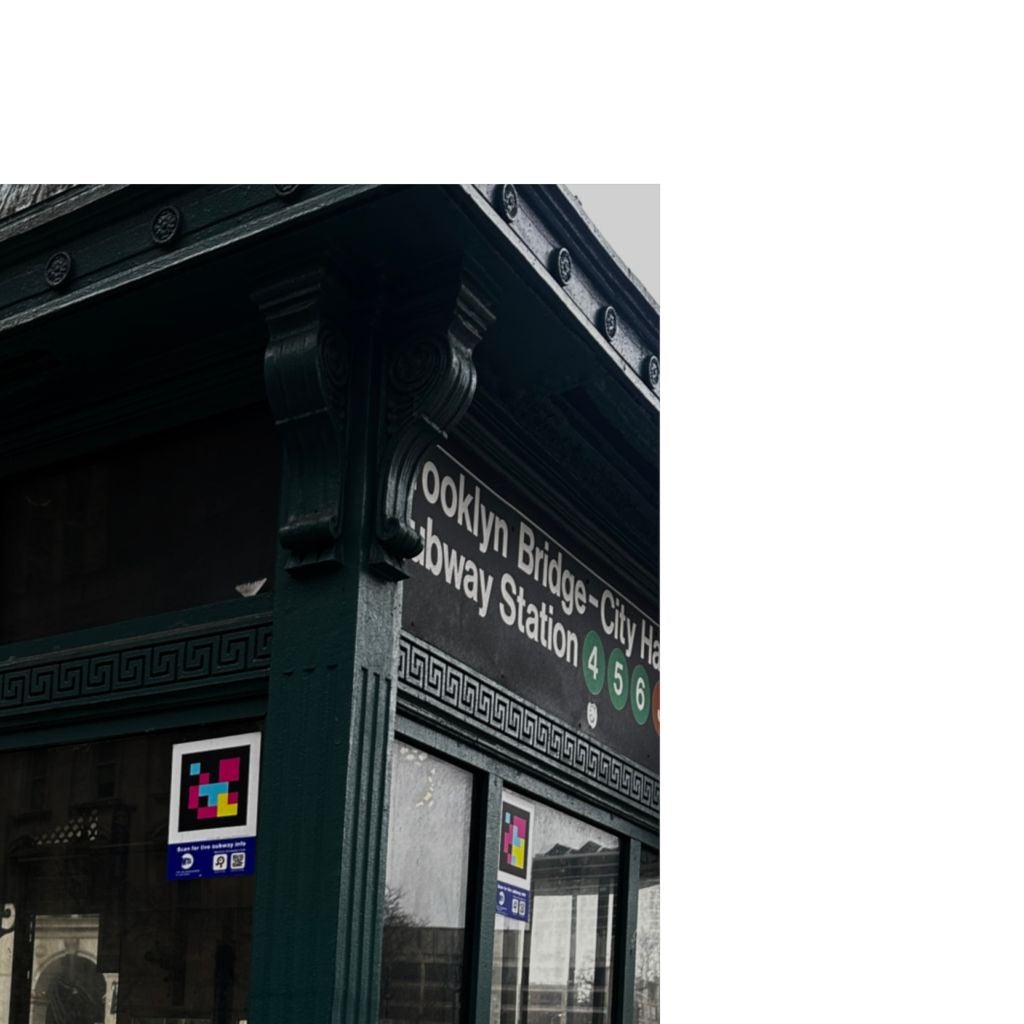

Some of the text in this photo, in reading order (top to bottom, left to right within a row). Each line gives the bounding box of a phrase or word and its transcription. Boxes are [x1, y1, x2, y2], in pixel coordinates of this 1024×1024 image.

[421, 460, 509, 559] ooklyn
[499, 573, 579, 668] Station
[587, 645, 599, 680] 4
[613, 660, 624, 696] 5
[636, 676, 646, 711] 6
[176, 845, 191, 853] Scan
[211, 842, 234, 850] subway
